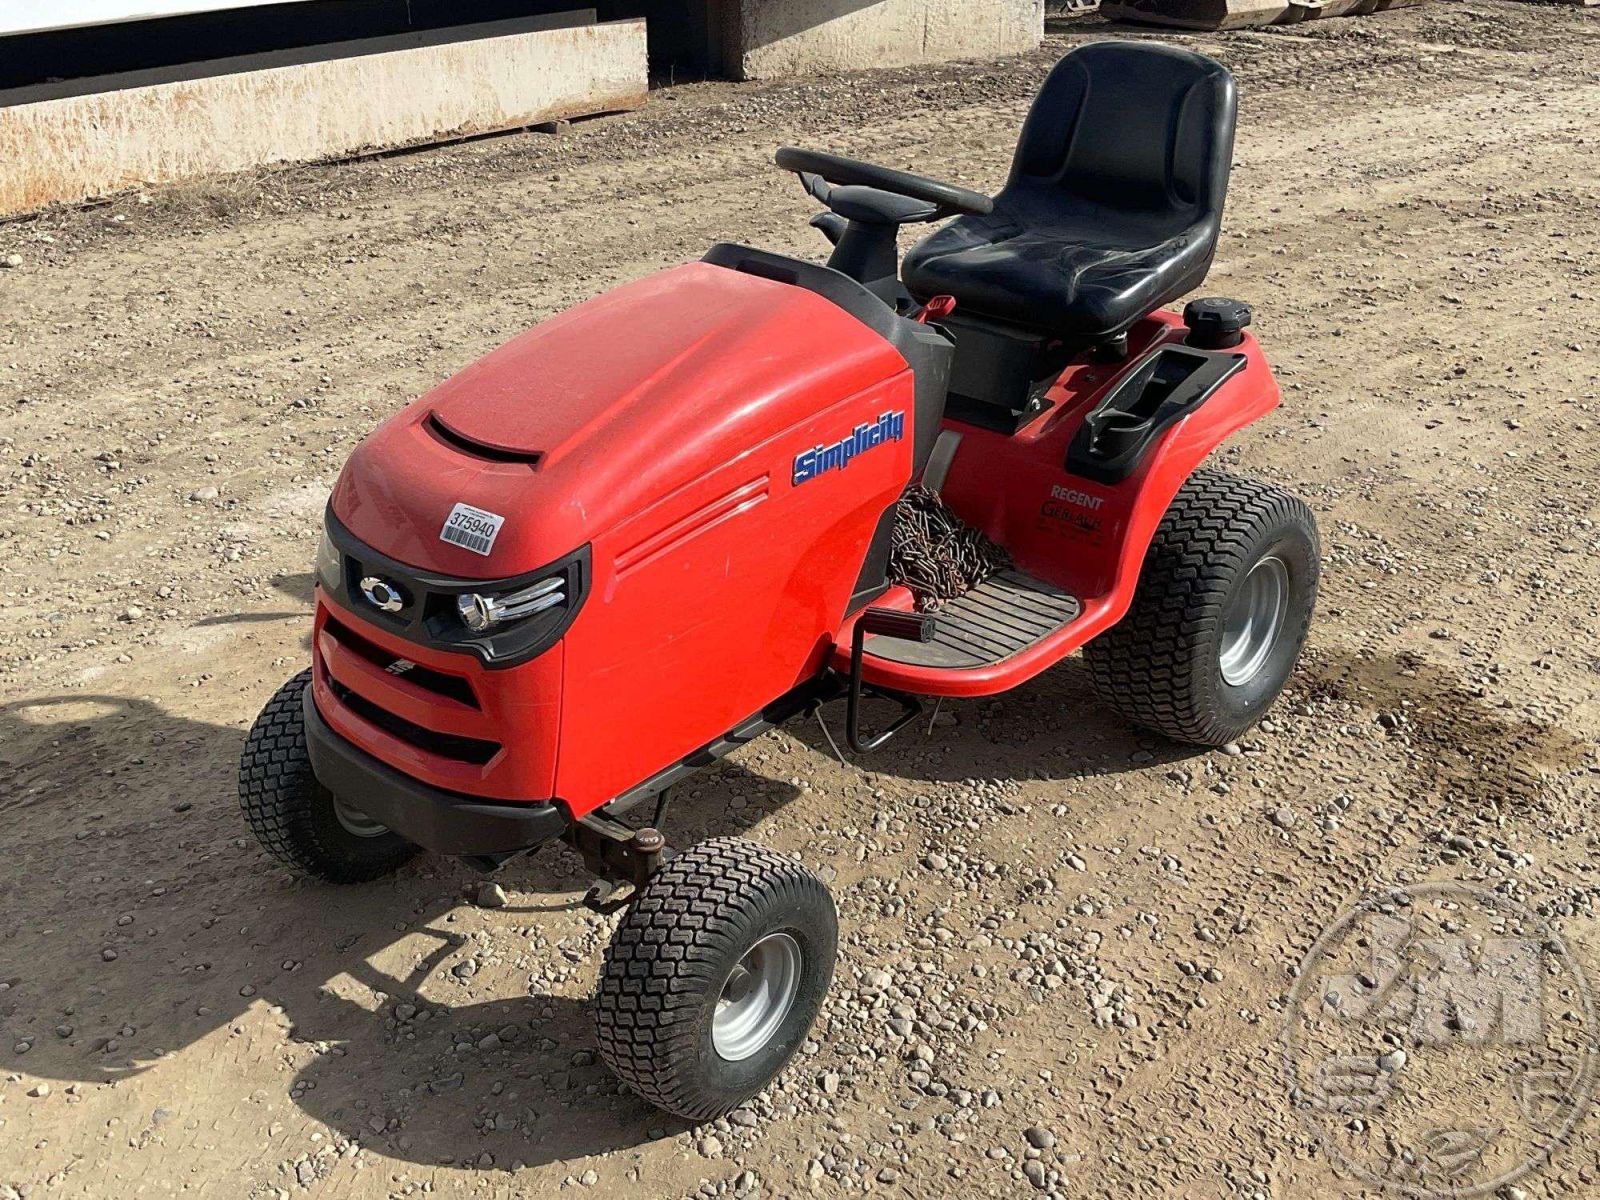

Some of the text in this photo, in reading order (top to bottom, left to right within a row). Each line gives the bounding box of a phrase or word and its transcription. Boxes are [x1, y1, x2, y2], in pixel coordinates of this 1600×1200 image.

[793, 409, 904, 487] Simplicity
[1050, 484, 1105, 511] REGENT
[450, 512, 495, 538] 375940
